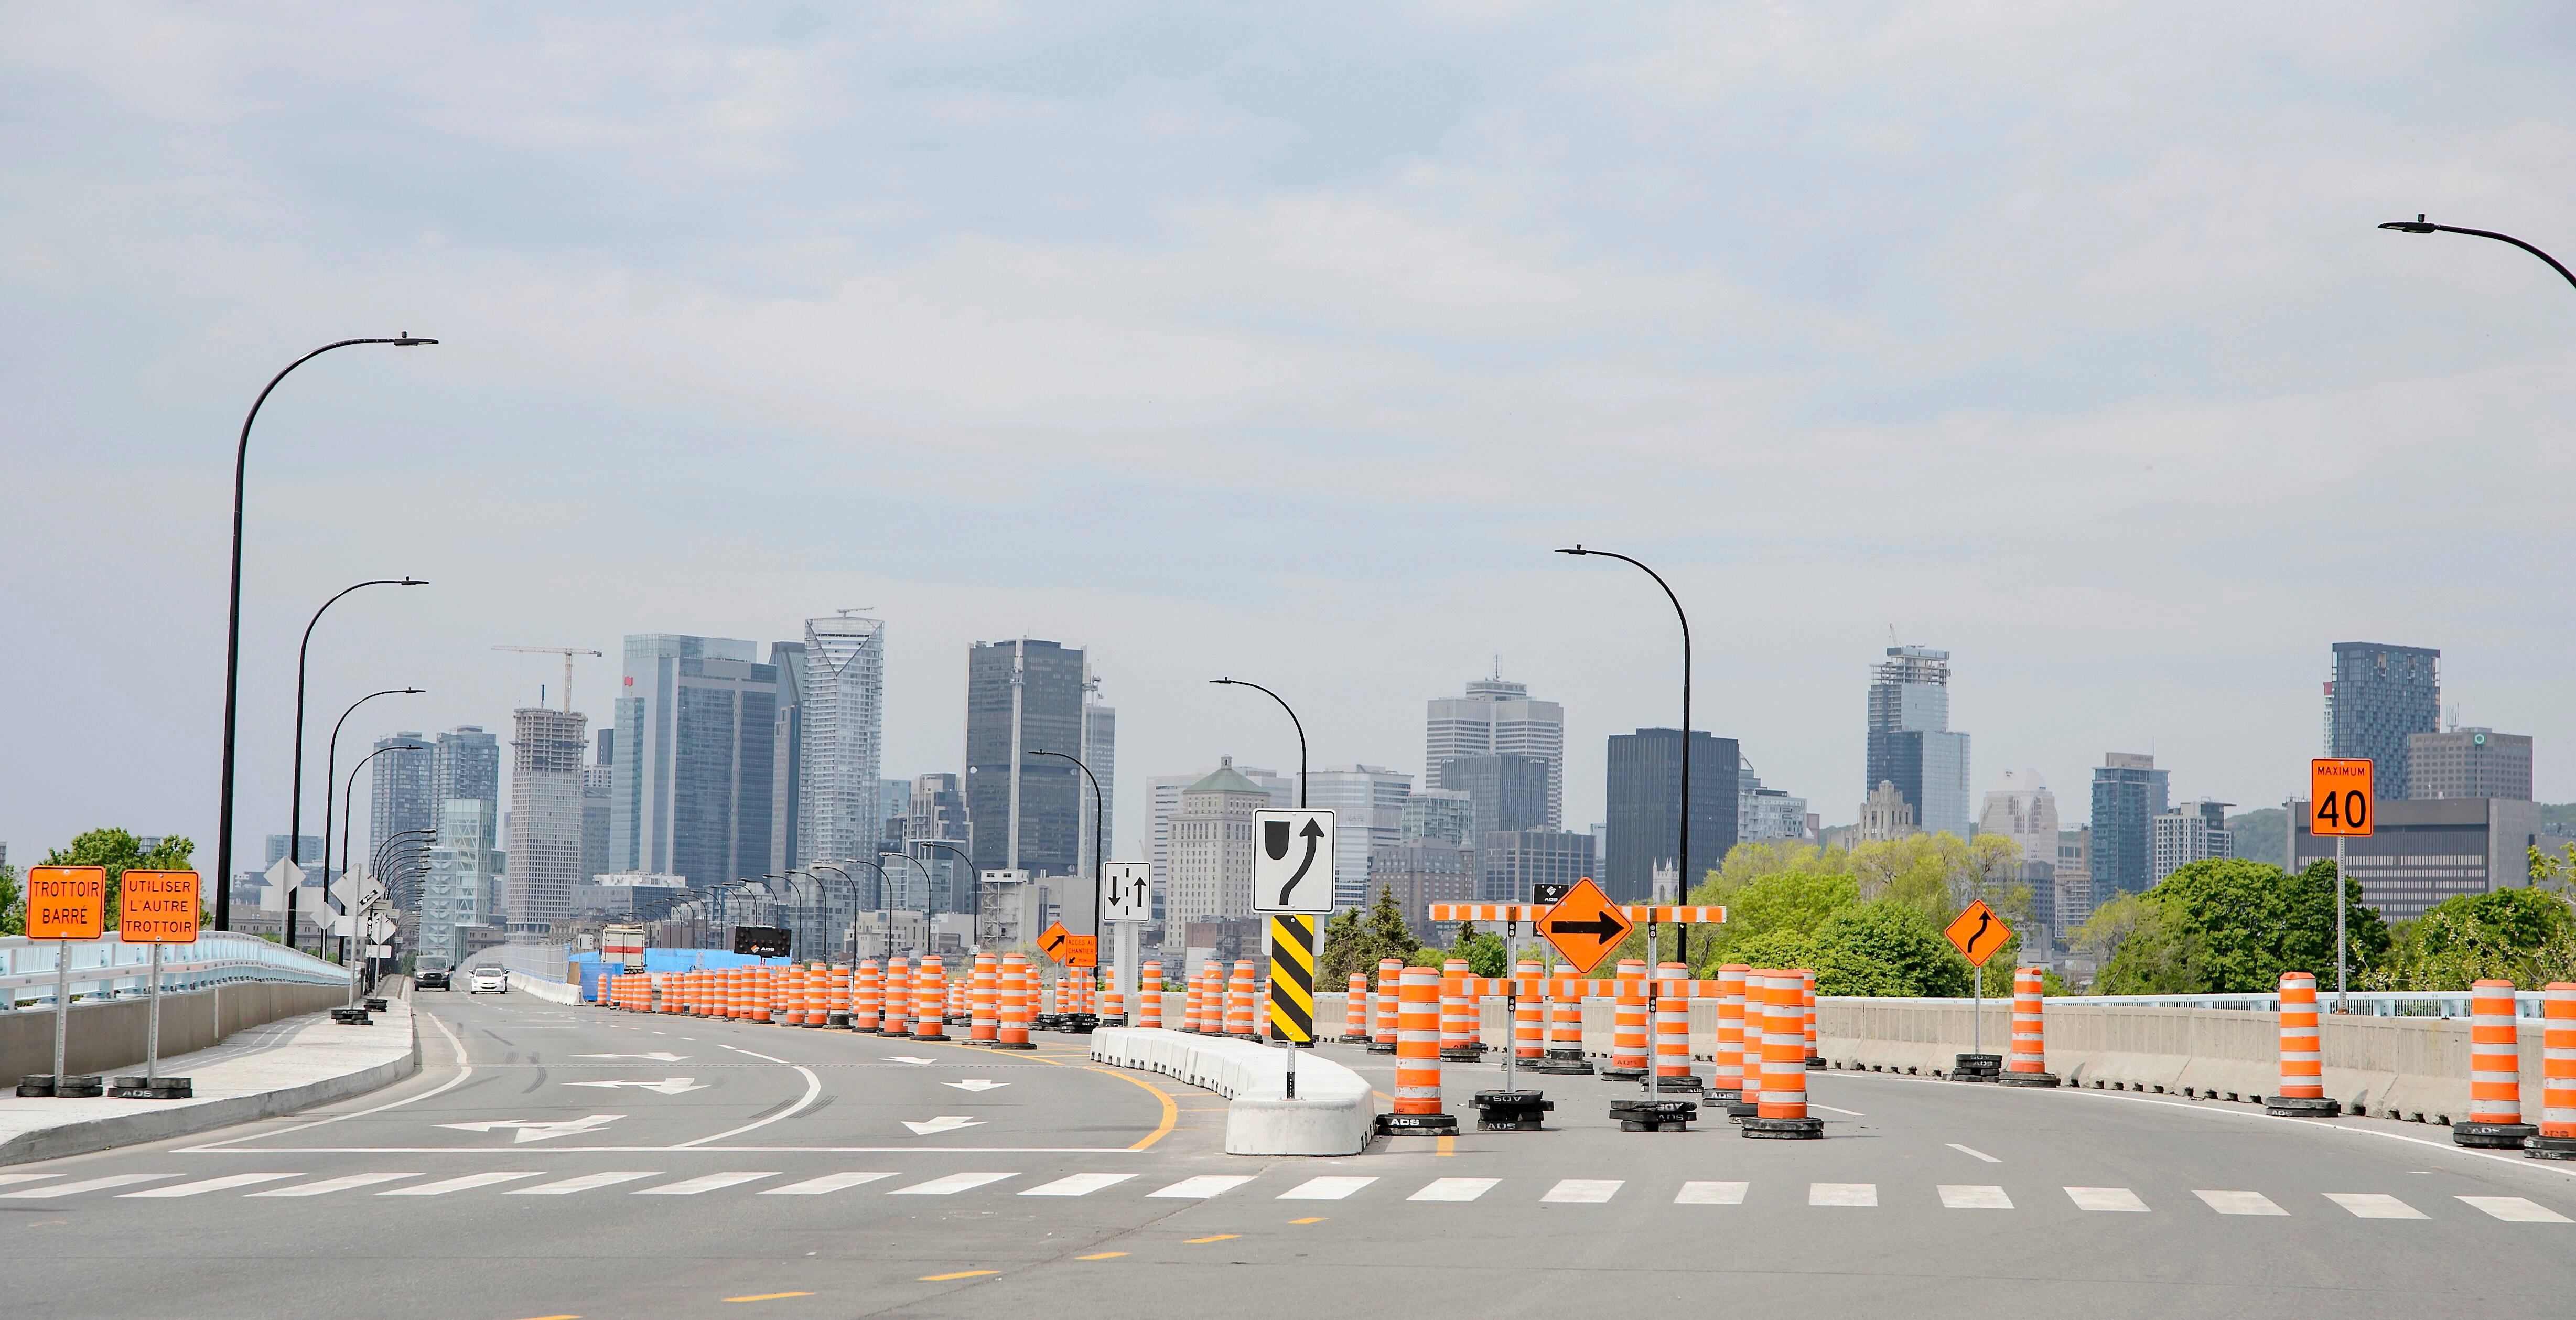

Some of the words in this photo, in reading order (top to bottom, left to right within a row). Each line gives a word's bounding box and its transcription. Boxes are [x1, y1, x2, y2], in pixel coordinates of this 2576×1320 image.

[2318, 766, 2365, 776] MAXIMUM
[2317, 790, 2366, 828] 40
[34, 881, 99, 897] TROTTOIR
[130, 881, 190, 892] UTILISER
[130, 900, 188, 912] L'AUTRE
[42, 905, 88, 924] BARRÉ
[125, 921, 192, 932] TROTTOIR
